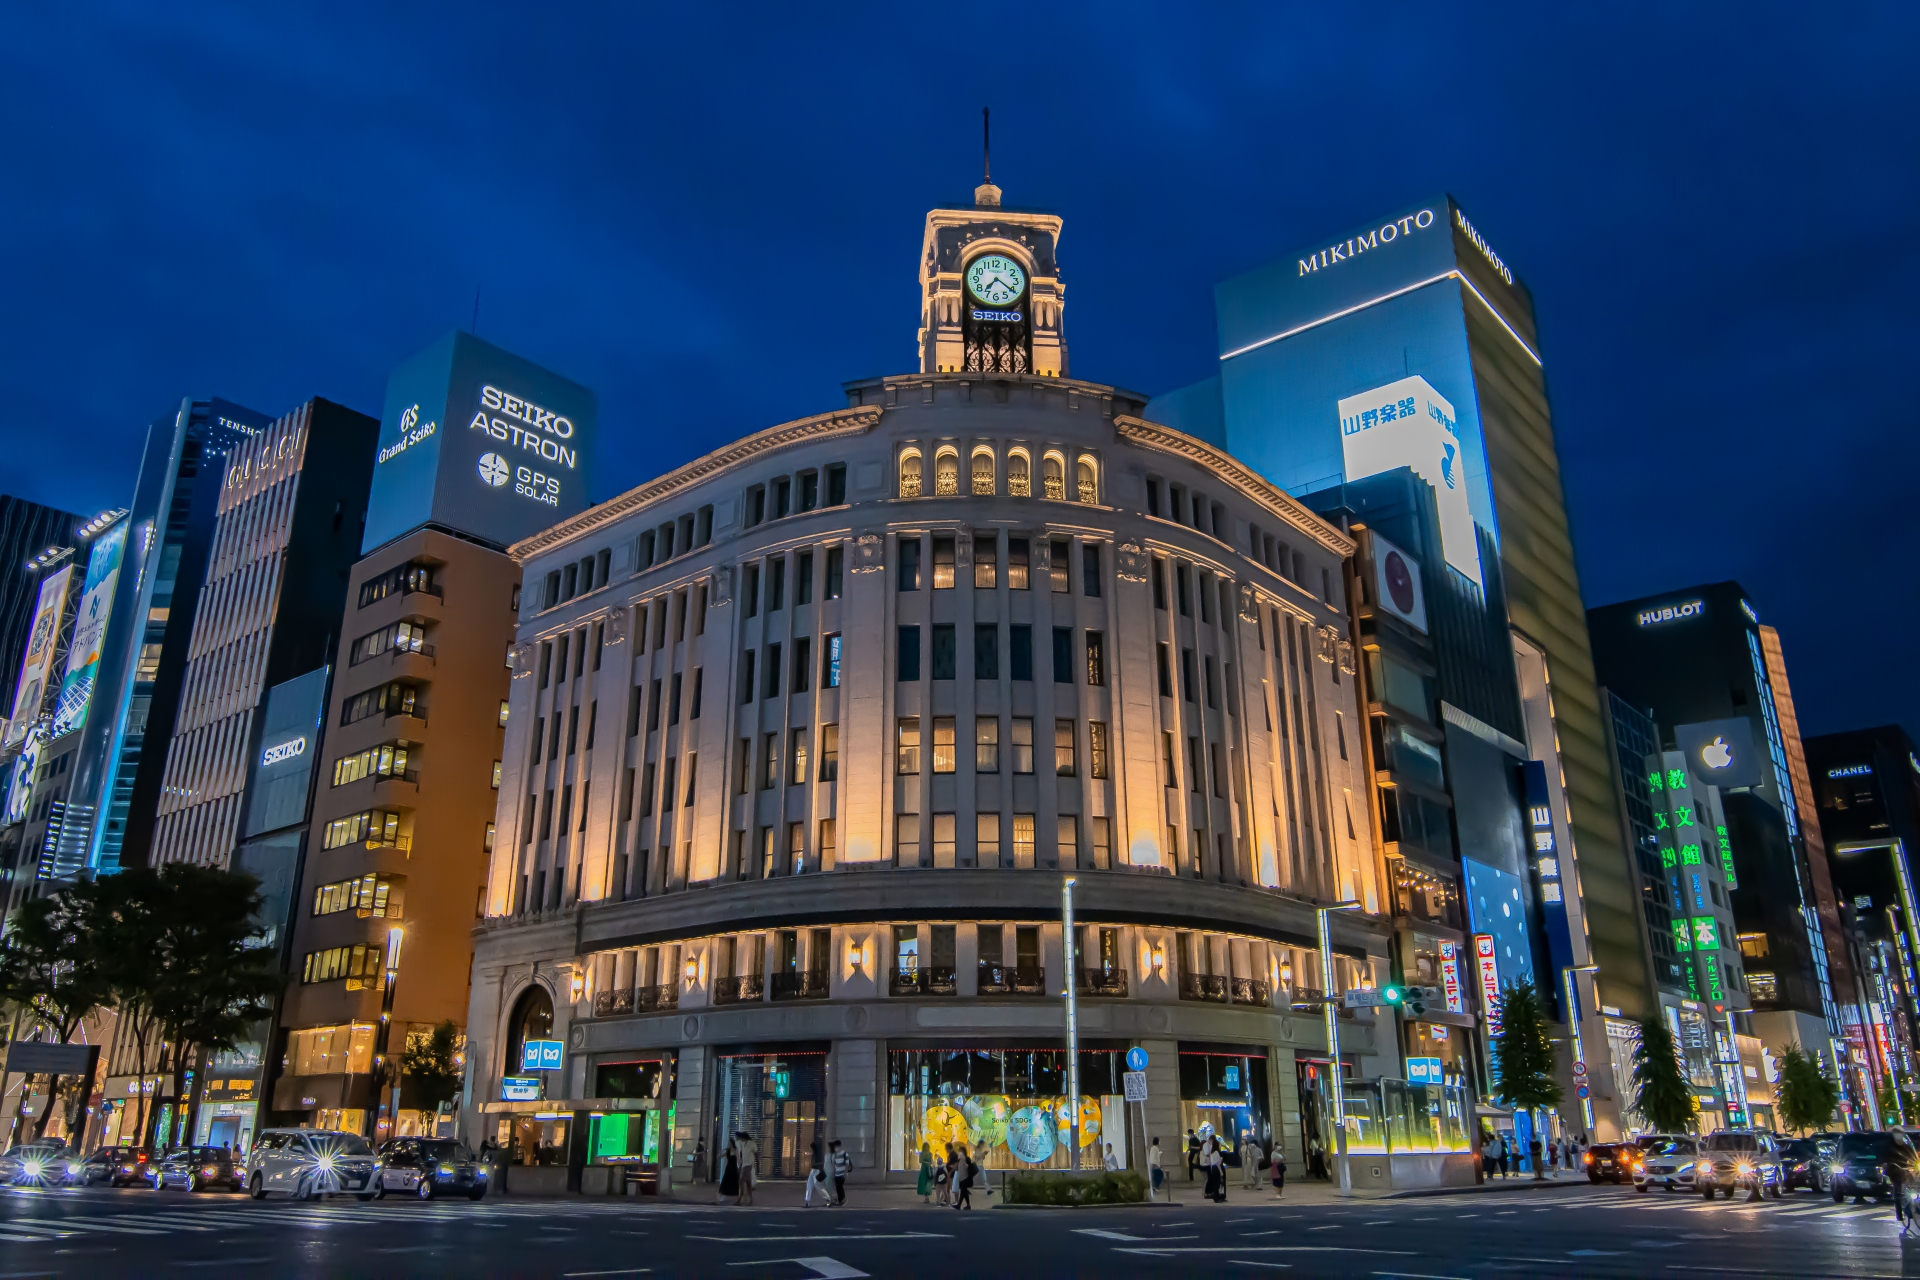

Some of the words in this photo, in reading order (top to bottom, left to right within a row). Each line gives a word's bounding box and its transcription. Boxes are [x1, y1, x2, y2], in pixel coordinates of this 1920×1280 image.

[1299, 209, 1435, 276] MIKIMOTO
[1456, 209, 1514, 285] MIKIMOTO
[992, 260, 1000, 268] 12
[973, 275, 980, 283] 9
[976, 284, 983, 292] 8
[1013, 277, 1019, 286] 3
[984, 290, 991, 298] 7
[993, 293, 999, 301] 6
[1002, 291, 1009, 299] 5
[972, 311, 1022, 322] SEIKO
[400, 404, 420, 432] GS
[481, 385, 574, 439] SEIKO
[1343, 397, 1417, 436] 山野楽器
[218, 417, 262, 436] TENSH
[378, 434, 408, 464] Grand
[408, 421, 437, 446] Seiko
[469, 412, 576, 469] ASTRON
[516, 466, 560, 495] GPS
[515, 483, 559, 507] SOLAR
[1638, 600, 1703, 625] HUBLOT
[262, 737, 306, 767] SEIKO
[1828, 764, 1872, 778] CHANEL
[1667, 768, 1701, 866] 教文館
[1716, 825, 1736, 883] 教文館ビル
[1694, 921, 1715, 945] 本
